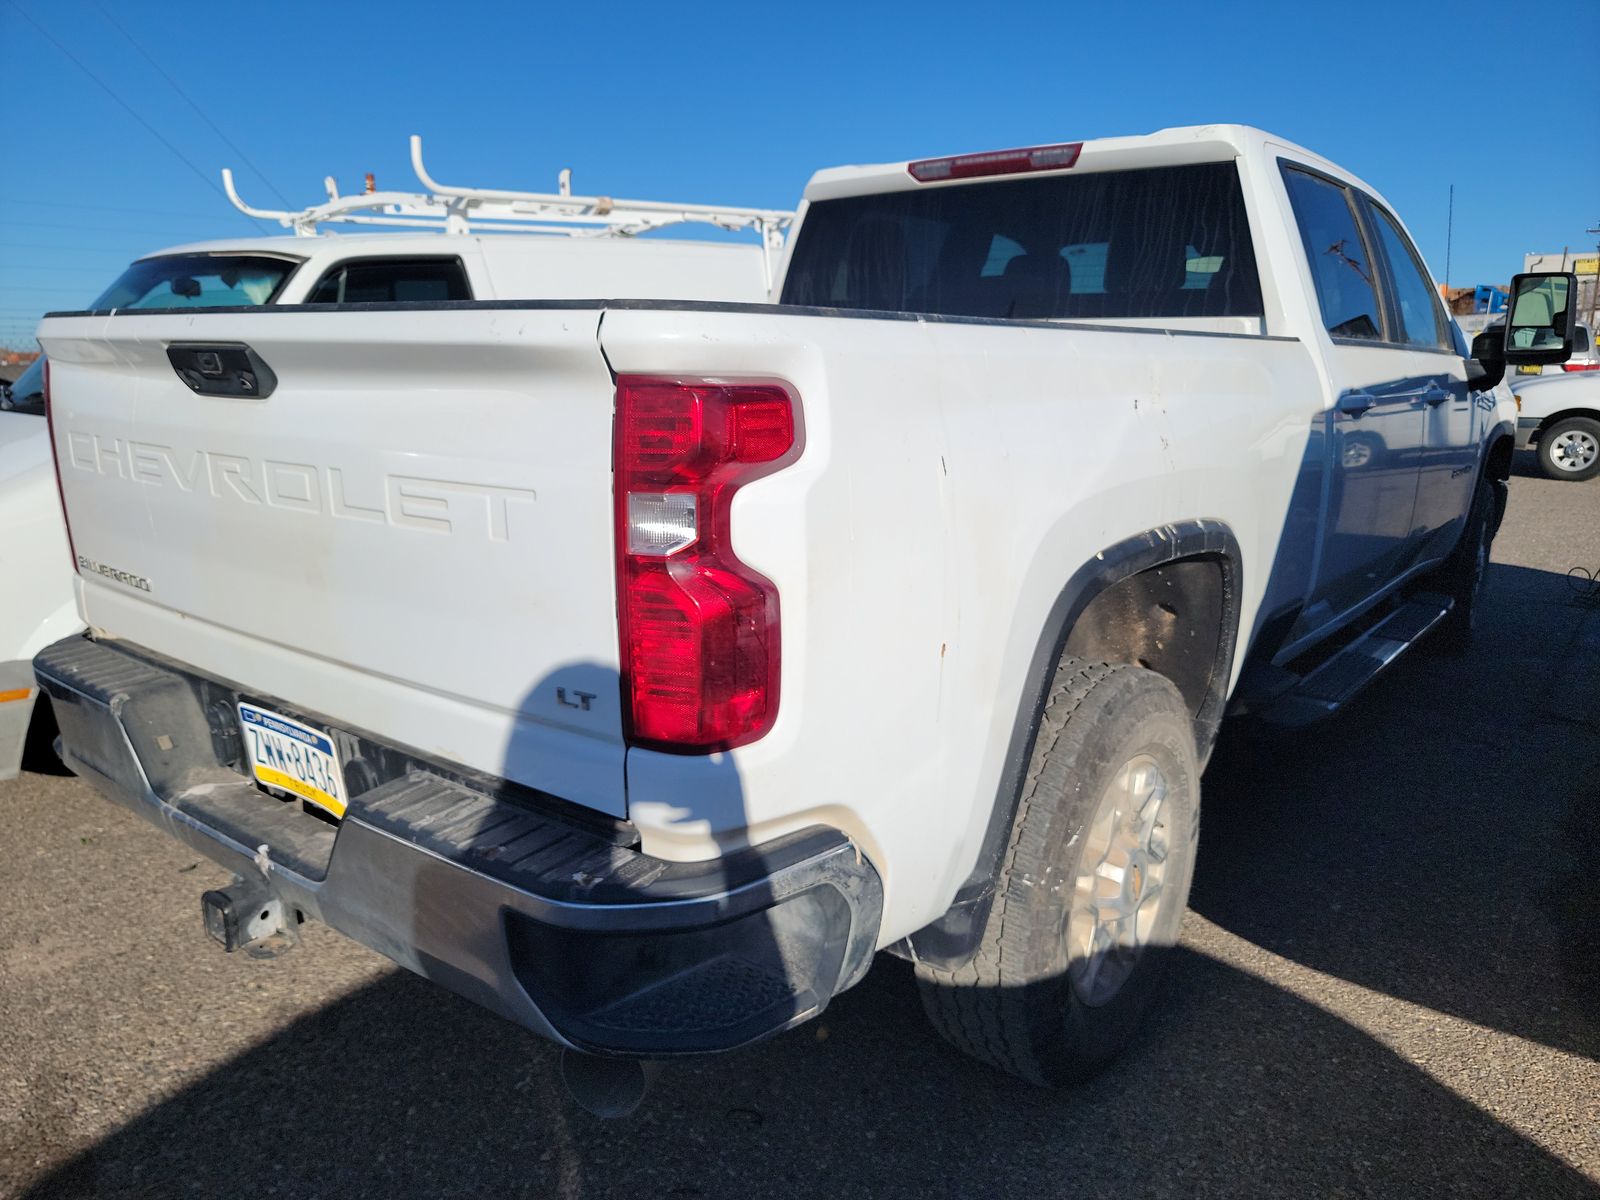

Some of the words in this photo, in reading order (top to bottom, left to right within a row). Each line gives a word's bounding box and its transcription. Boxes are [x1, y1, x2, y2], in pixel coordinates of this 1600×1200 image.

[68, 432, 536, 542] CHEVROLET
[79, 555, 151, 593] SILVERADO
[557, 687, 597, 711] LT
